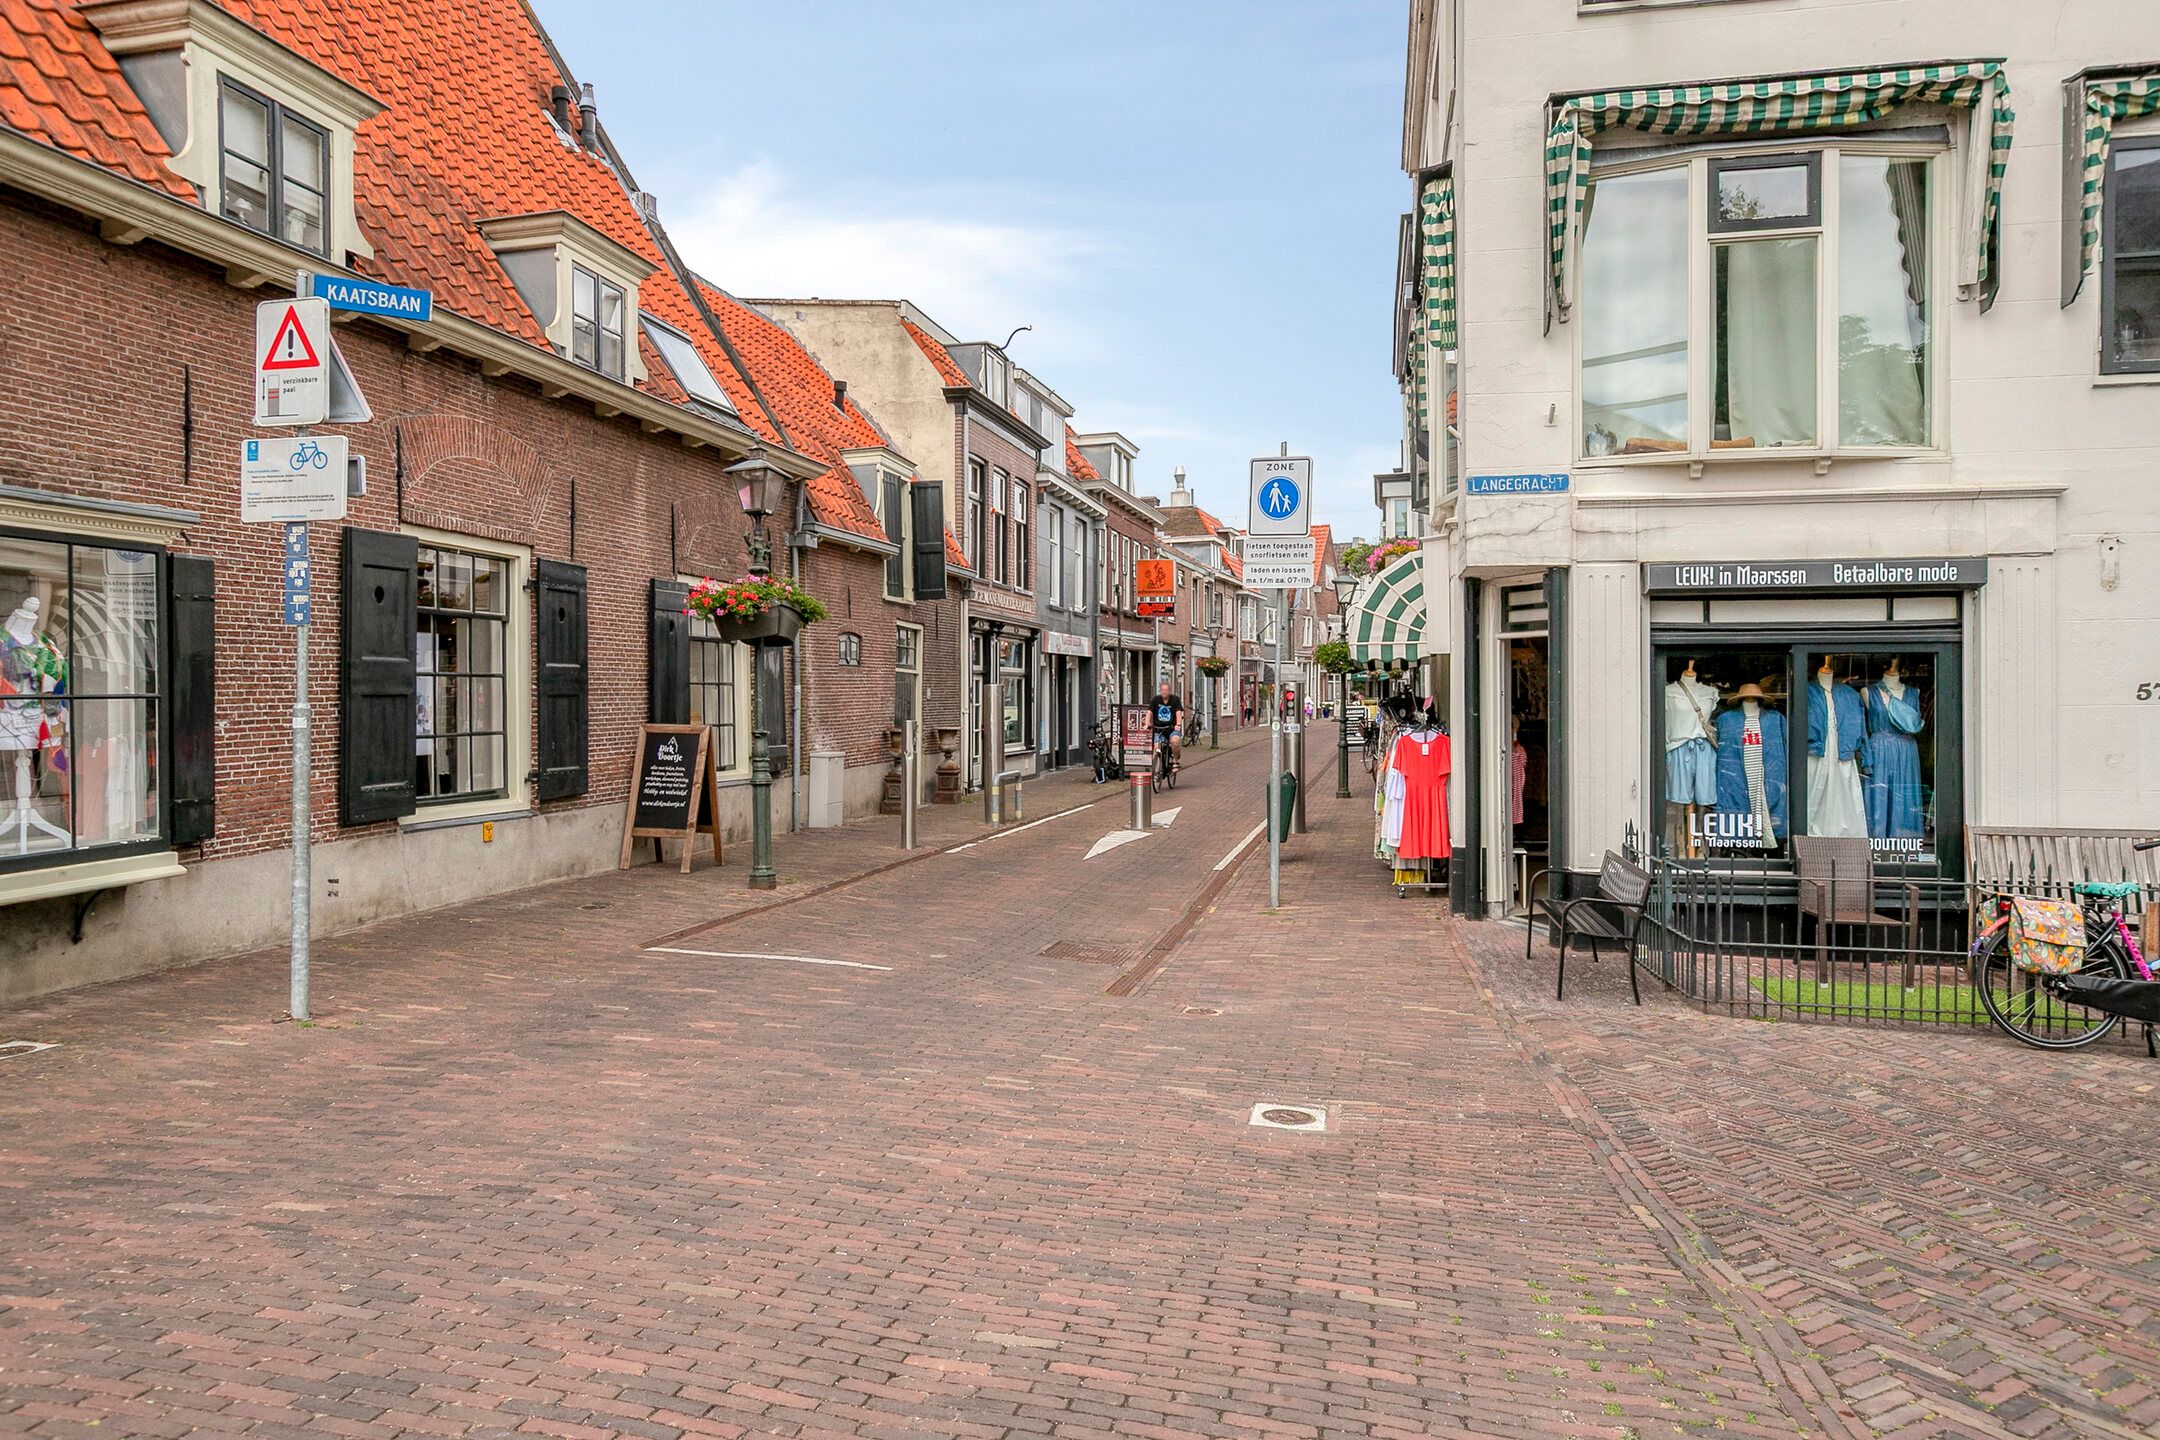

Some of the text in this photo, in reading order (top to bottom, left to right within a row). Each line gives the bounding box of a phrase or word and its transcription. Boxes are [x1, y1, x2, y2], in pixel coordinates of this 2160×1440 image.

[327, 284, 420, 313] KAATSBAAN
[283, 376, 318, 384] verzinkbare
[283, 386, 296, 394] paal
[1266, 463, 1294, 471] ZONE
[1472, 477, 1563, 492] LANGEGRACHT
[1273, 543, 1313, 551] toegestaan
[1675, 561, 1957, 586] LEUK! in Maarssen Betaalbare mode
[659, 745, 675, 754] Dirk
[643, 788, 658, 796] Hobby
[1690, 813, 1763, 838] LEUK!
[1690, 836, 1763, 848] in Maarssen
[1869, 838, 1923, 852] BOUTIQUE
